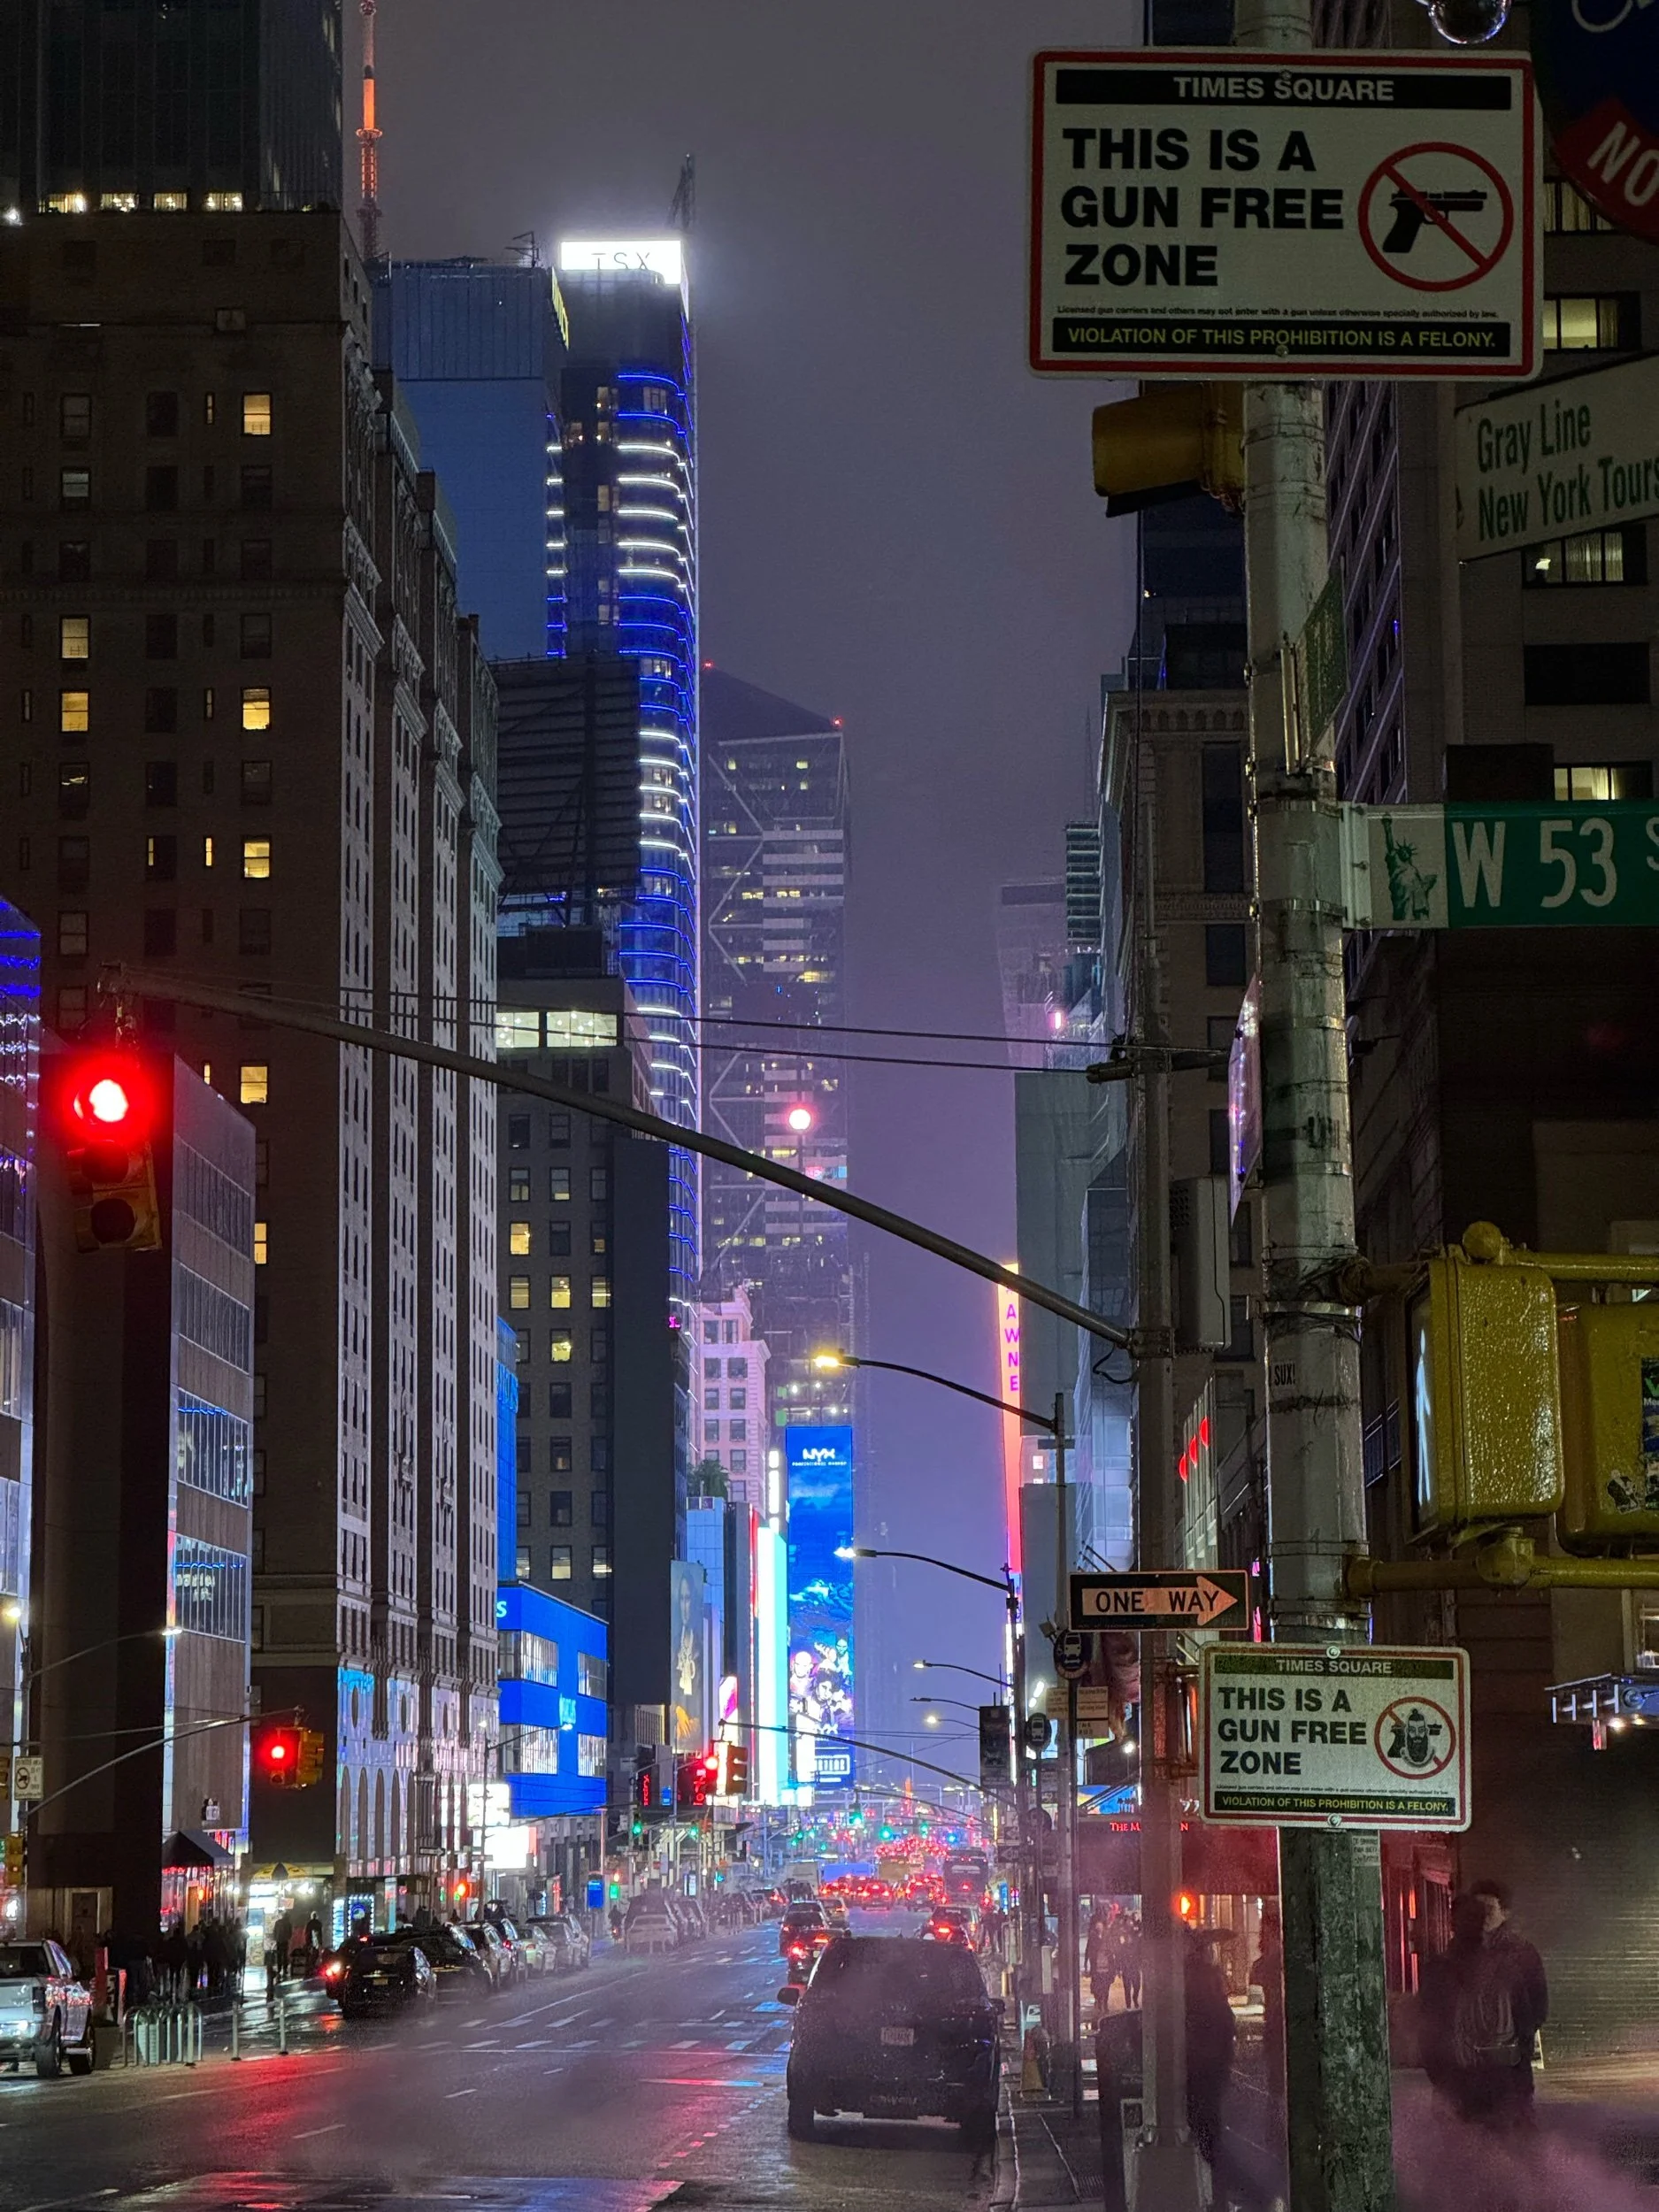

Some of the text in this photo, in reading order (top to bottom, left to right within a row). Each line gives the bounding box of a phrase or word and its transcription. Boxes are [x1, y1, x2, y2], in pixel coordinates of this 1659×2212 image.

[1174, 76, 1395, 102] TIMES SQUARE
[1063, 127, 1317, 172] THIS IS A
[1586, 121, 1659, 206] NO
[1061, 186, 1344, 229] GUN FREE
[591, 252, 650, 270] TSX
[1064, 244, 1218, 286] ZONE
[1068, 327, 1496, 348] VIOLATION OF THIS PROHIBITION IS A FELONY.
[1478, 398, 1590, 475] Gray Line
[1479, 486, 1529, 541] New
[1538, 464, 1592, 526] York
[1452, 822, 1505, 908] W
[1540, 818, 1618, 908] 53
[1274, 1363, 1295, 1386] SUX!
[803, 1448, 835, 1462] NYX
[1095, 1591, 1219, 1612] ONE WAY
[1277, 1659, 1392, 1674] TIMES SQUARE
[1218, 1687, 1351, 1712] THIS IS A
[1217, 1719, 1367, 1745] GUN FREE
[1220, 1751, 1302, 1775] ZONE
[1223, 1796, 1449, 1811] VIOLATION OF THIS PROHIBITION IS A FELONY.
[1110, 1822, 1128, 1832] THE
